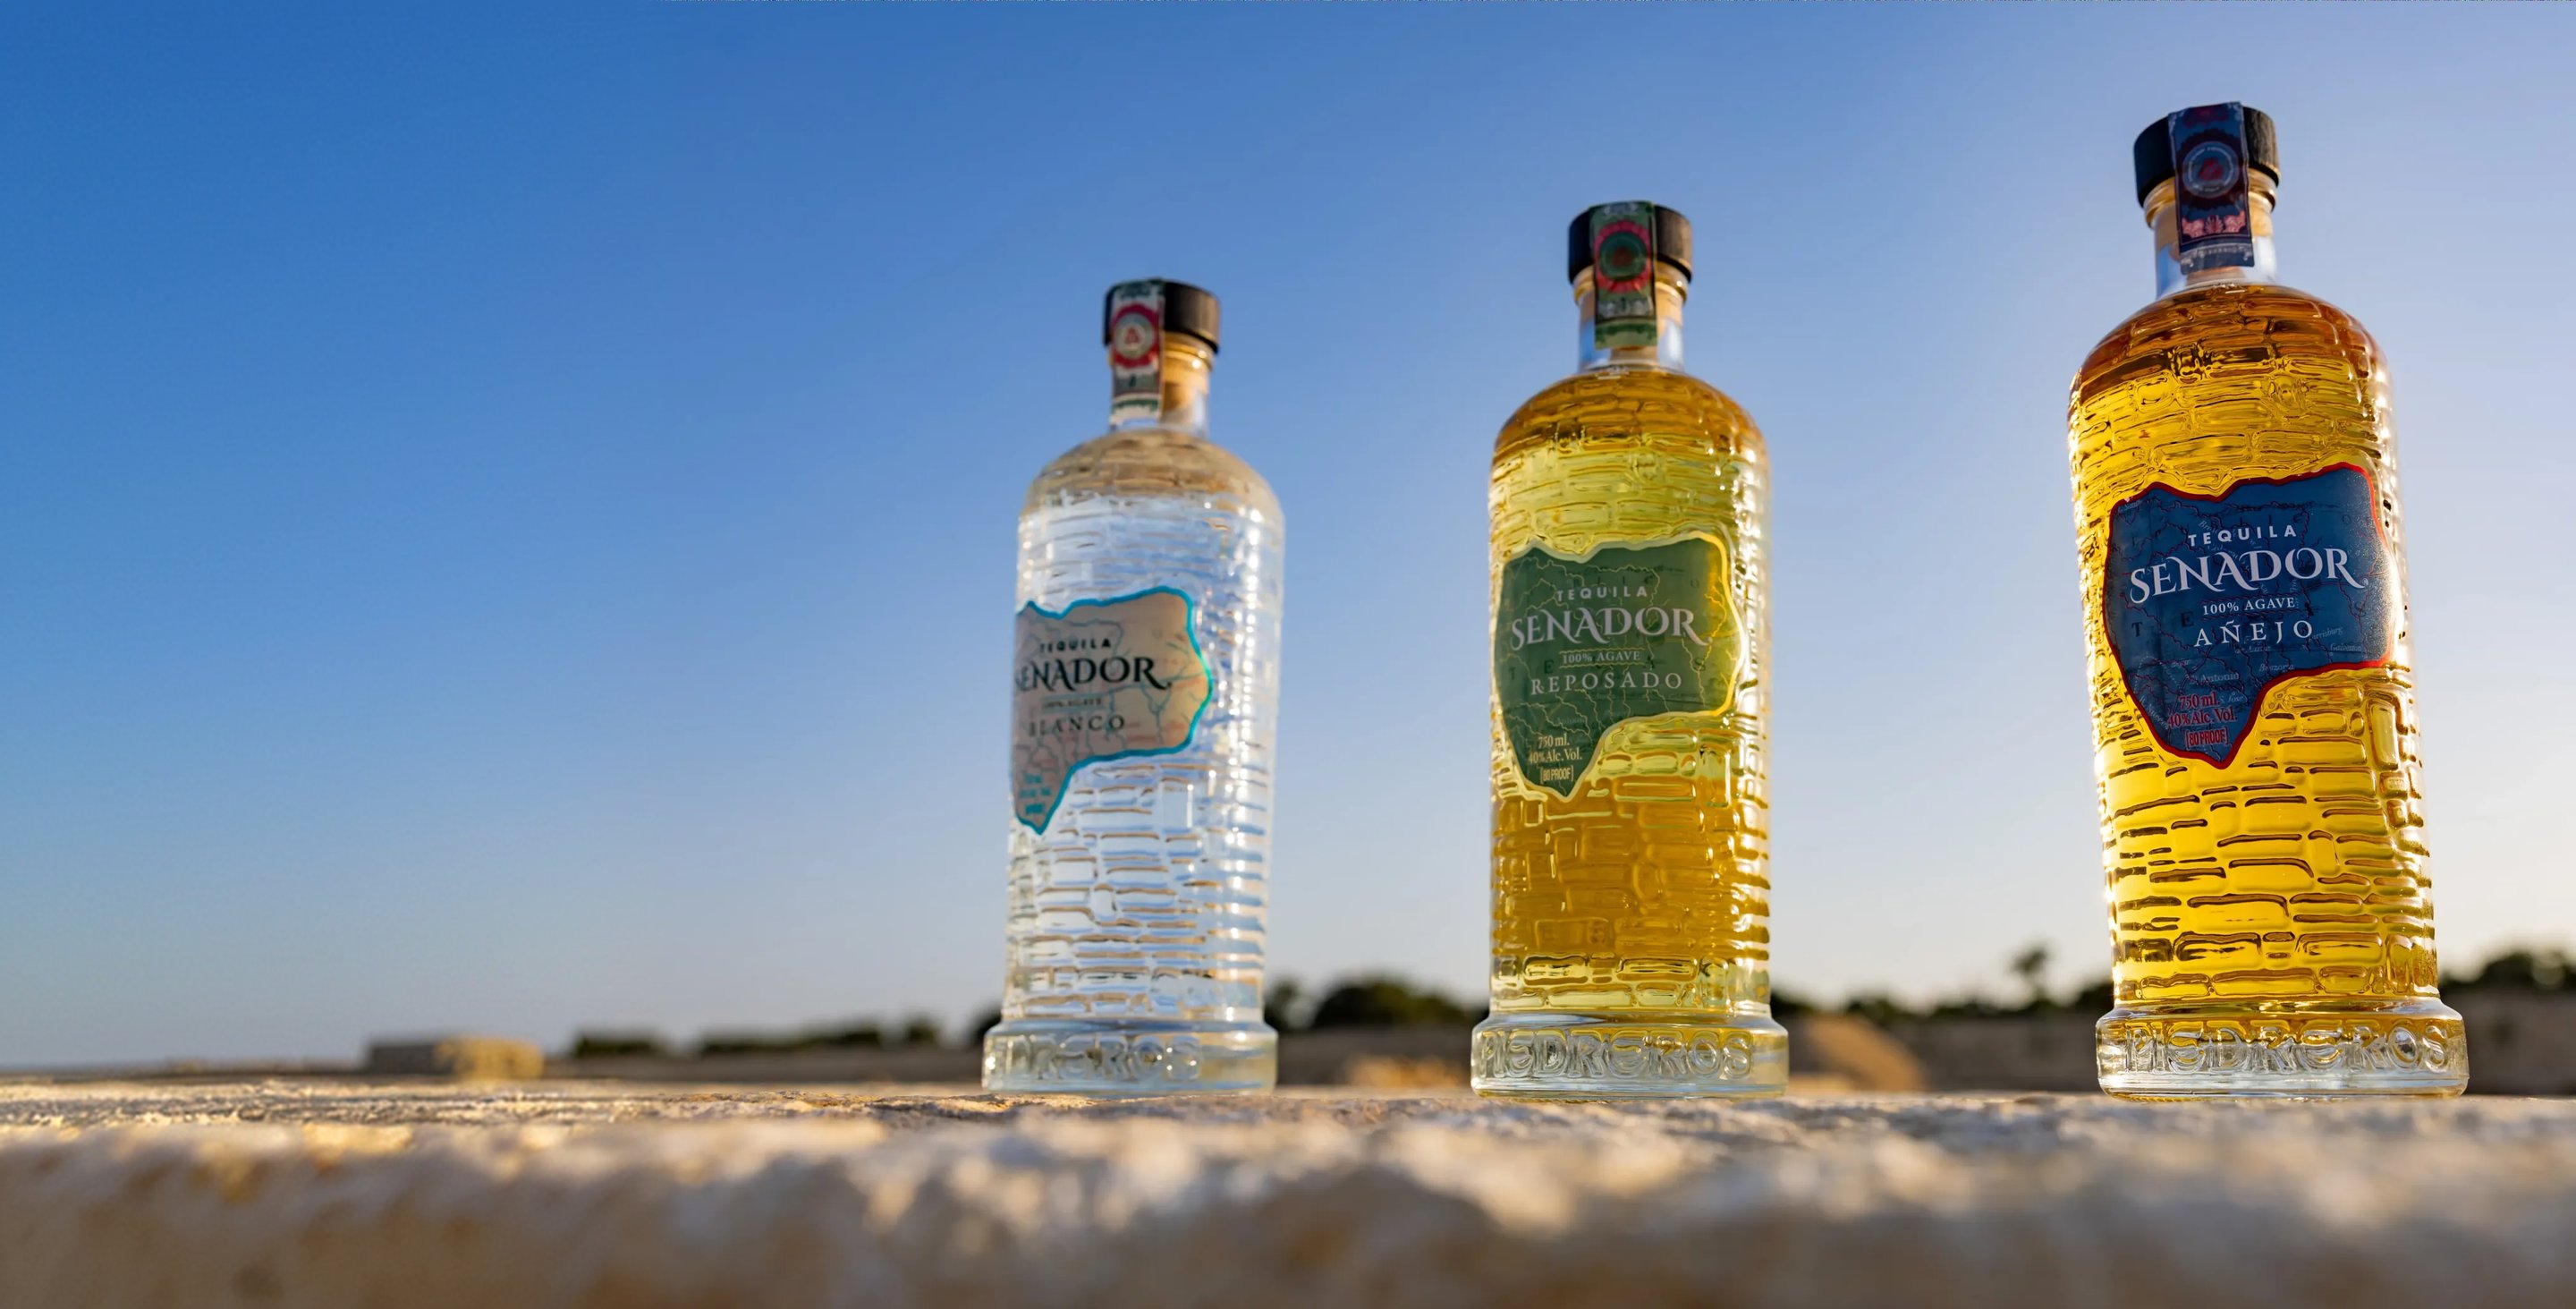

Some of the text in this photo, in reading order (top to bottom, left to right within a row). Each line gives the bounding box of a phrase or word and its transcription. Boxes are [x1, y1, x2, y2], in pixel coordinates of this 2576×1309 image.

[2188, 524, 2297, 547] TEQUILA
[2130, 548, 2368, 605] SENADOR
[1556, 585, 1648, 602] TEQUILA
[2202, 597, 2296, 616] 100% AGAVE
[1511, 607, 1713, 651] SENADOR
[2193, 620, 2313, 648] AÑEJO
[1039, 638, 1112, 653] TEQUILA
[1562, 650, 1641, 665] 100% AGAVE
[1530, 671, 1682, 695] REPOSADO
[2178, 690, 2220, 710] 750 ml.
[2168, 712, 2190, 729] 40%
[2213, 705, 2238, 721] Vol.
[1538, 734, 1554, 749] 750
